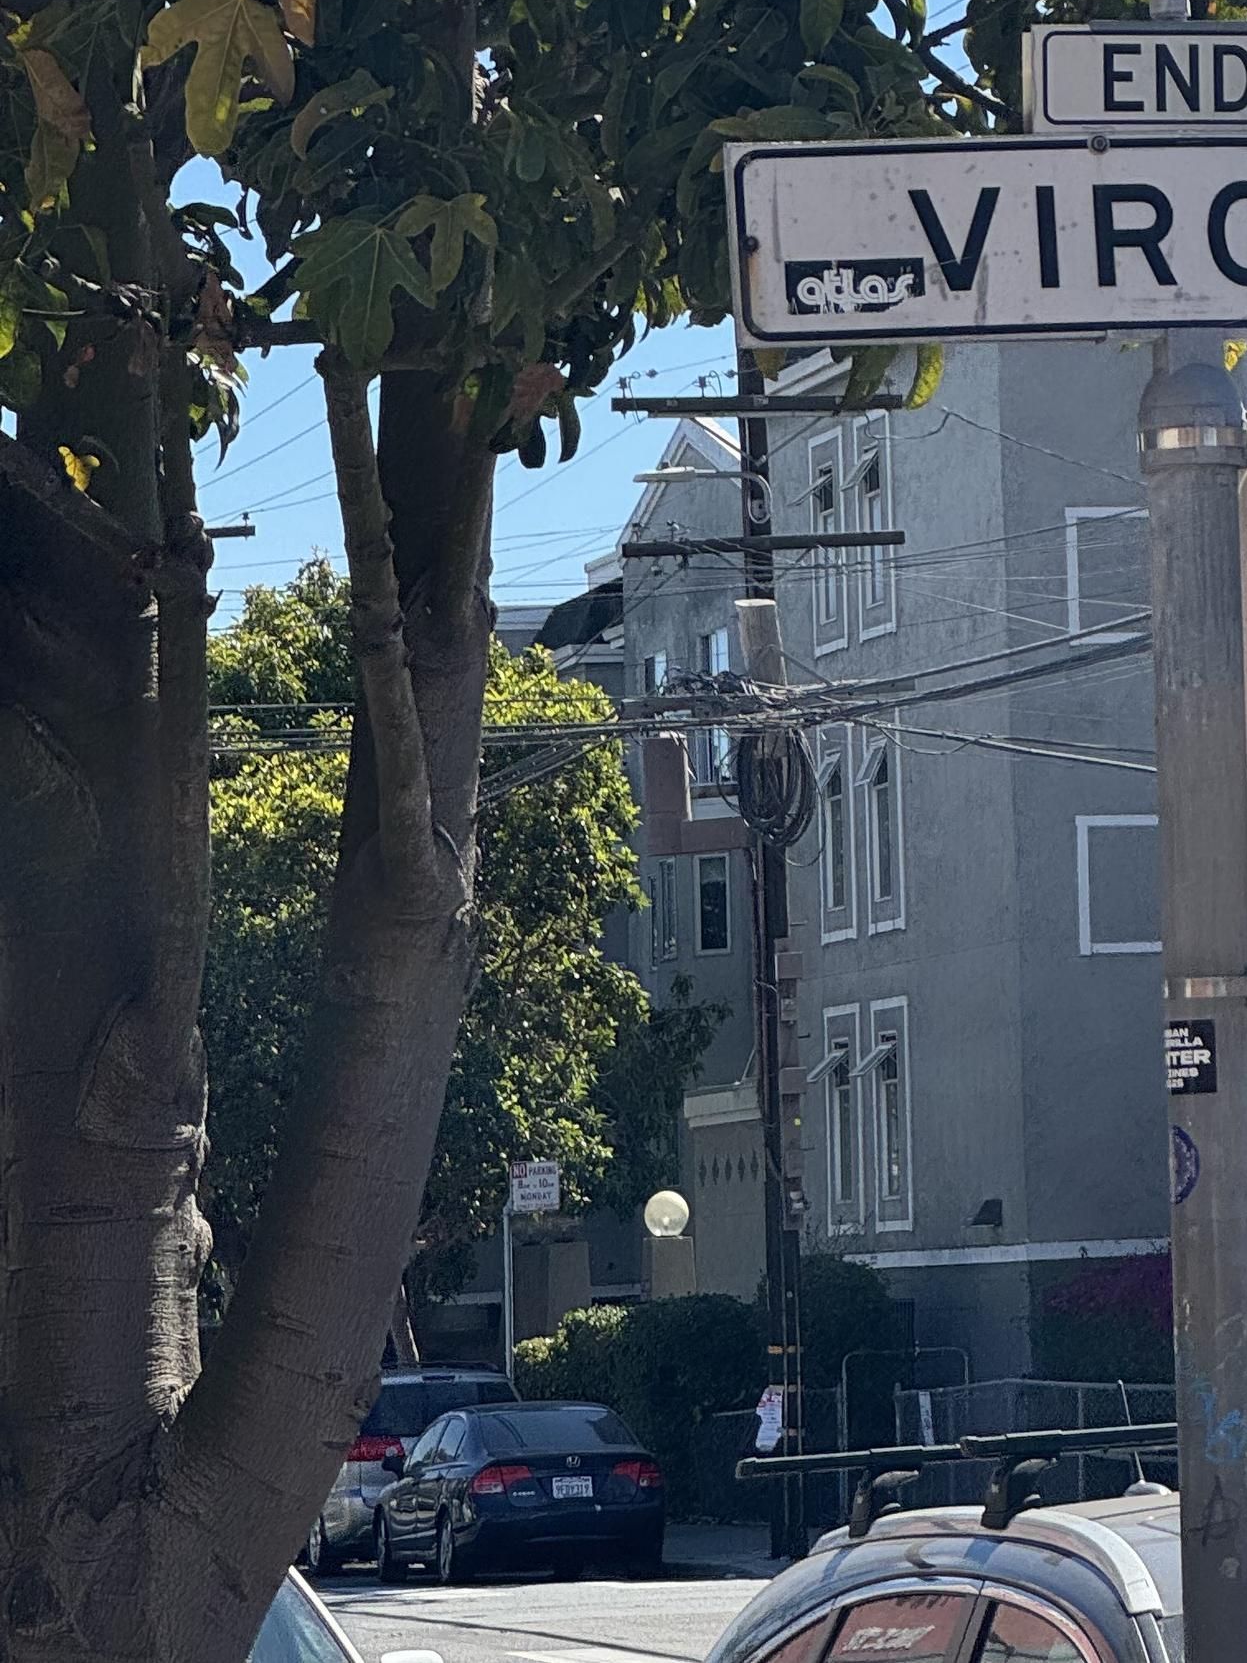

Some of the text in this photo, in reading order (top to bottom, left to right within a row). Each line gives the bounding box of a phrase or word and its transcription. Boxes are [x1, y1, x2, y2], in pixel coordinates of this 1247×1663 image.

[797, 268, 915, 307] atlas
[513, 1164, 557, 1177] NO PARKING
[520, 1192, 552, 1200] MONDAY
